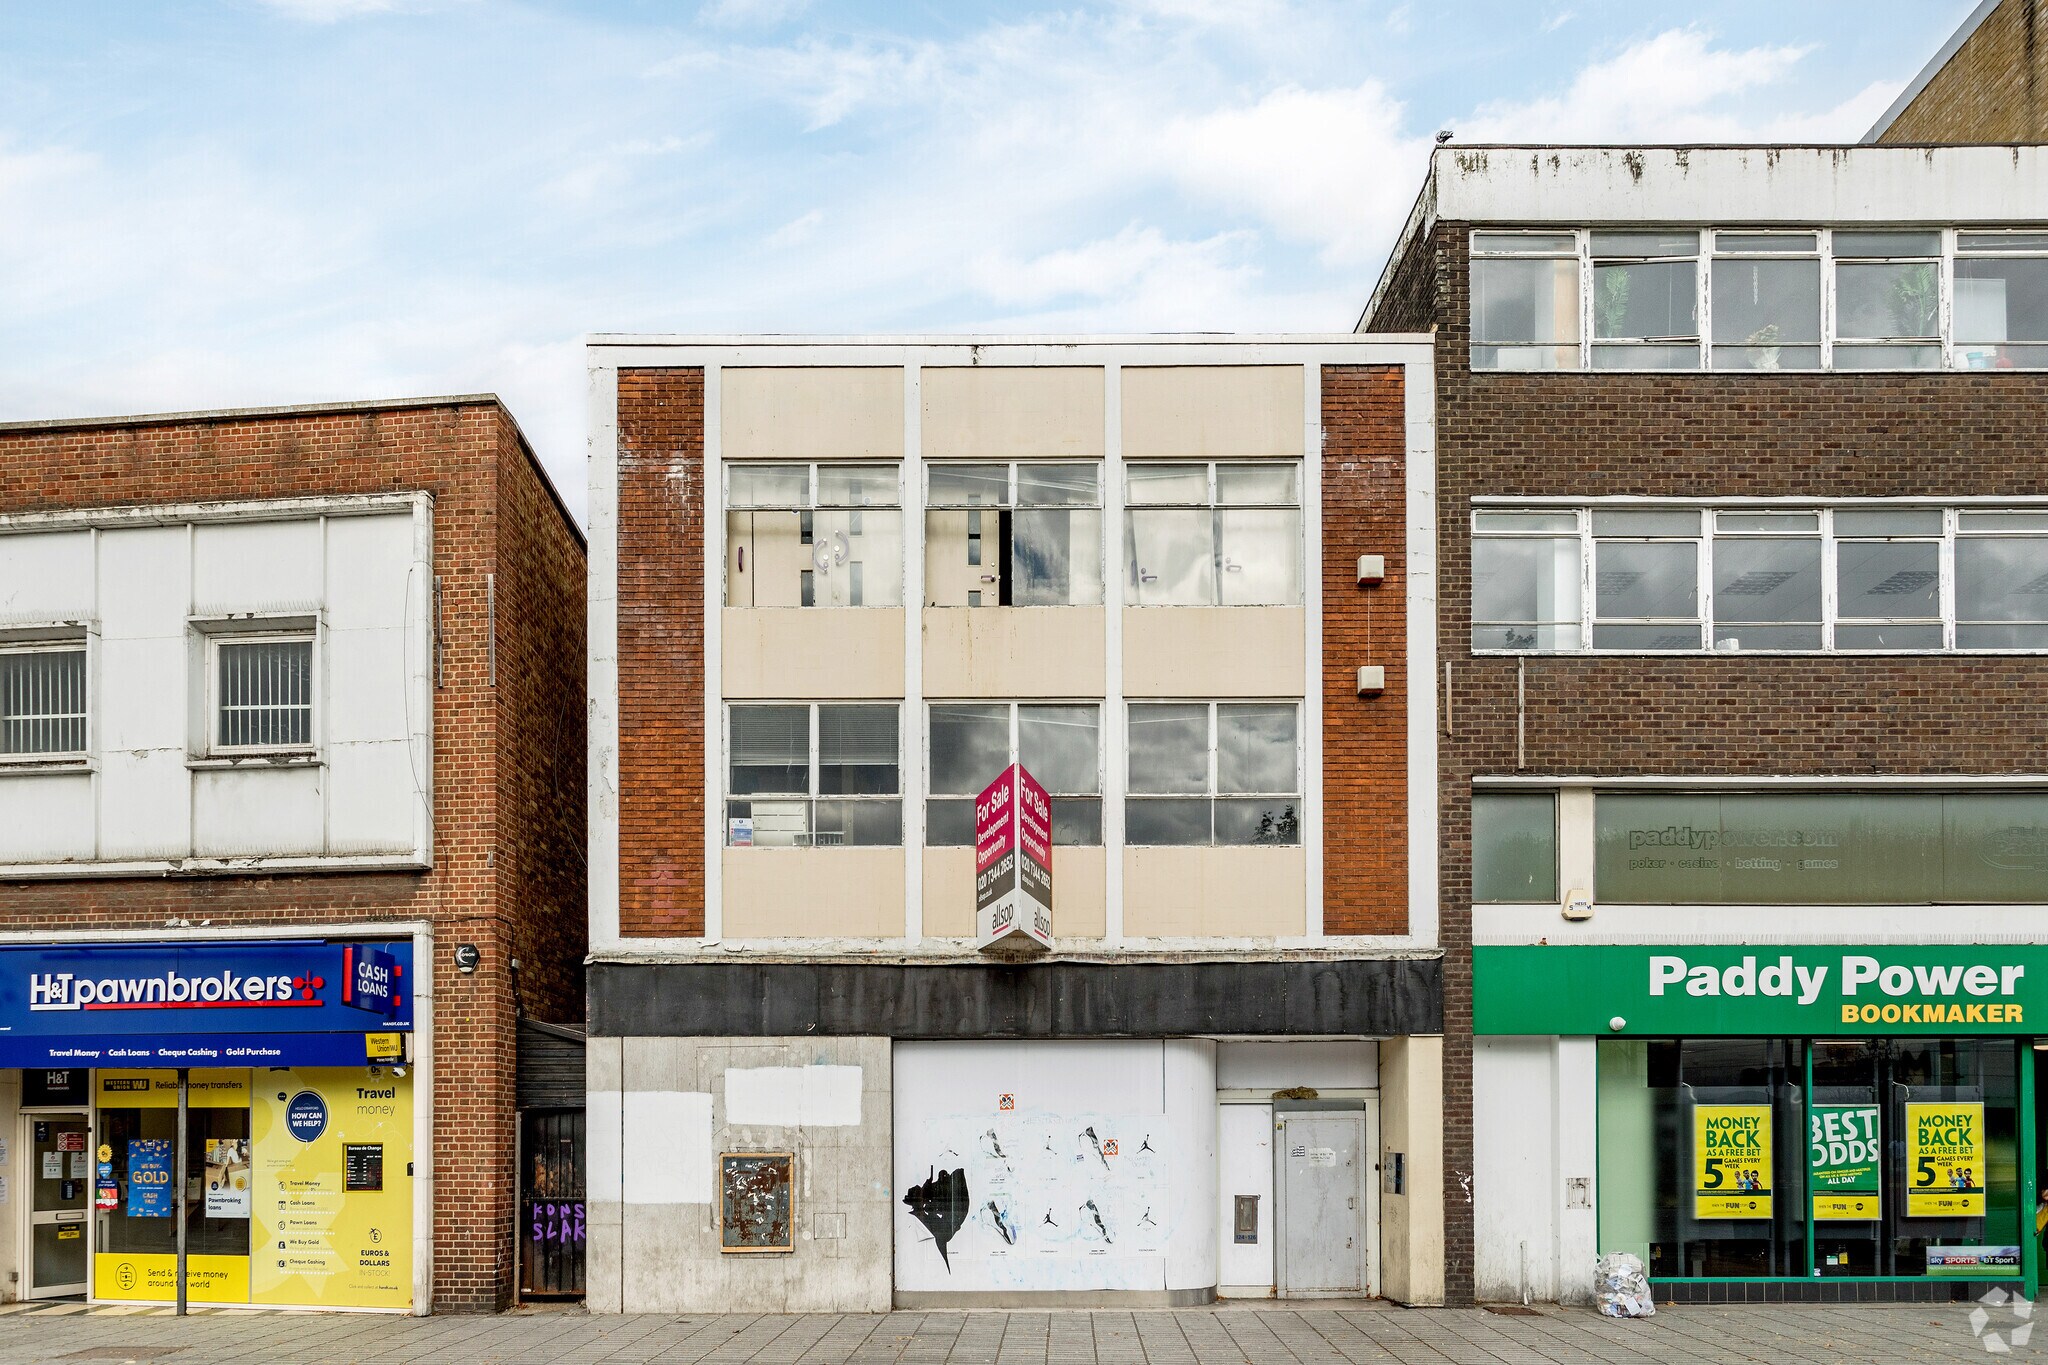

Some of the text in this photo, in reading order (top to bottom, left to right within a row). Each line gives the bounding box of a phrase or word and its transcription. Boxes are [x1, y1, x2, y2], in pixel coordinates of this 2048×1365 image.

[977, 784, 1009, 827] For Sale
[1021, 776, 1048, 822] For Sale
[978, 811, 1009, 846] Development
[1021, 807, 1048, 842] Development
[978, 835, 1006, 864] Opportunity
[1022, 827, 1046, 862] Opportunity
[1629, 827, 1839, 850] paddypower.com
[978, 854, 1014, 891] 020 7344 2652
[1021, 853, 1051, 890] 020 7344 2652
[1629, 857, 1839, 872] poker casino betting games
[992, 903, 1014, 930] allsop
[1034, 906, 1050, 936] allsop
[358, 962, 388, 983] CASH
[1649, 956, 2025, 1005] Paddy Power
[30, 970, 293, 1010] H&T pawnbrokers
[358, 979, 388, 998] LOANS
[1842, 1004, 2023, 1023] BOOKMAKER
[74, 1049, 100, 1058] Money
[158, 1048, 186, 1058] Cheque
[187, 1048, 218, 1058] Cashing
[226, 1048, 245, 1056] Gold
[246, 1048, 281, 1056] Purchase
[47, 1071, 70, 1084] H&T
[211, 1081, 242, 1089] transfers
[356, 1087, 395, 1098] Travel
[356, 1104, 395, 1116] money
[1918, 1115, 1973, 1127] MONEY
[1706, 1117, 1760, 1130] MONEY
[1812, 1109, 1877, 1143] BEST
[1706, 1130, 1761, 1148] BACK
[1918, 1128, 1973, 1146] BACK
[132, 1171, 169, 1184] GOLD
[1704, 1158, 1724, 1189] 5
[1917, 1156, 1936, 1187] 5
[533, 1219, 586, 1243] SLAK
[175, 1270, 201, 1278] reive
[203, 1271, 228, 1279] money
